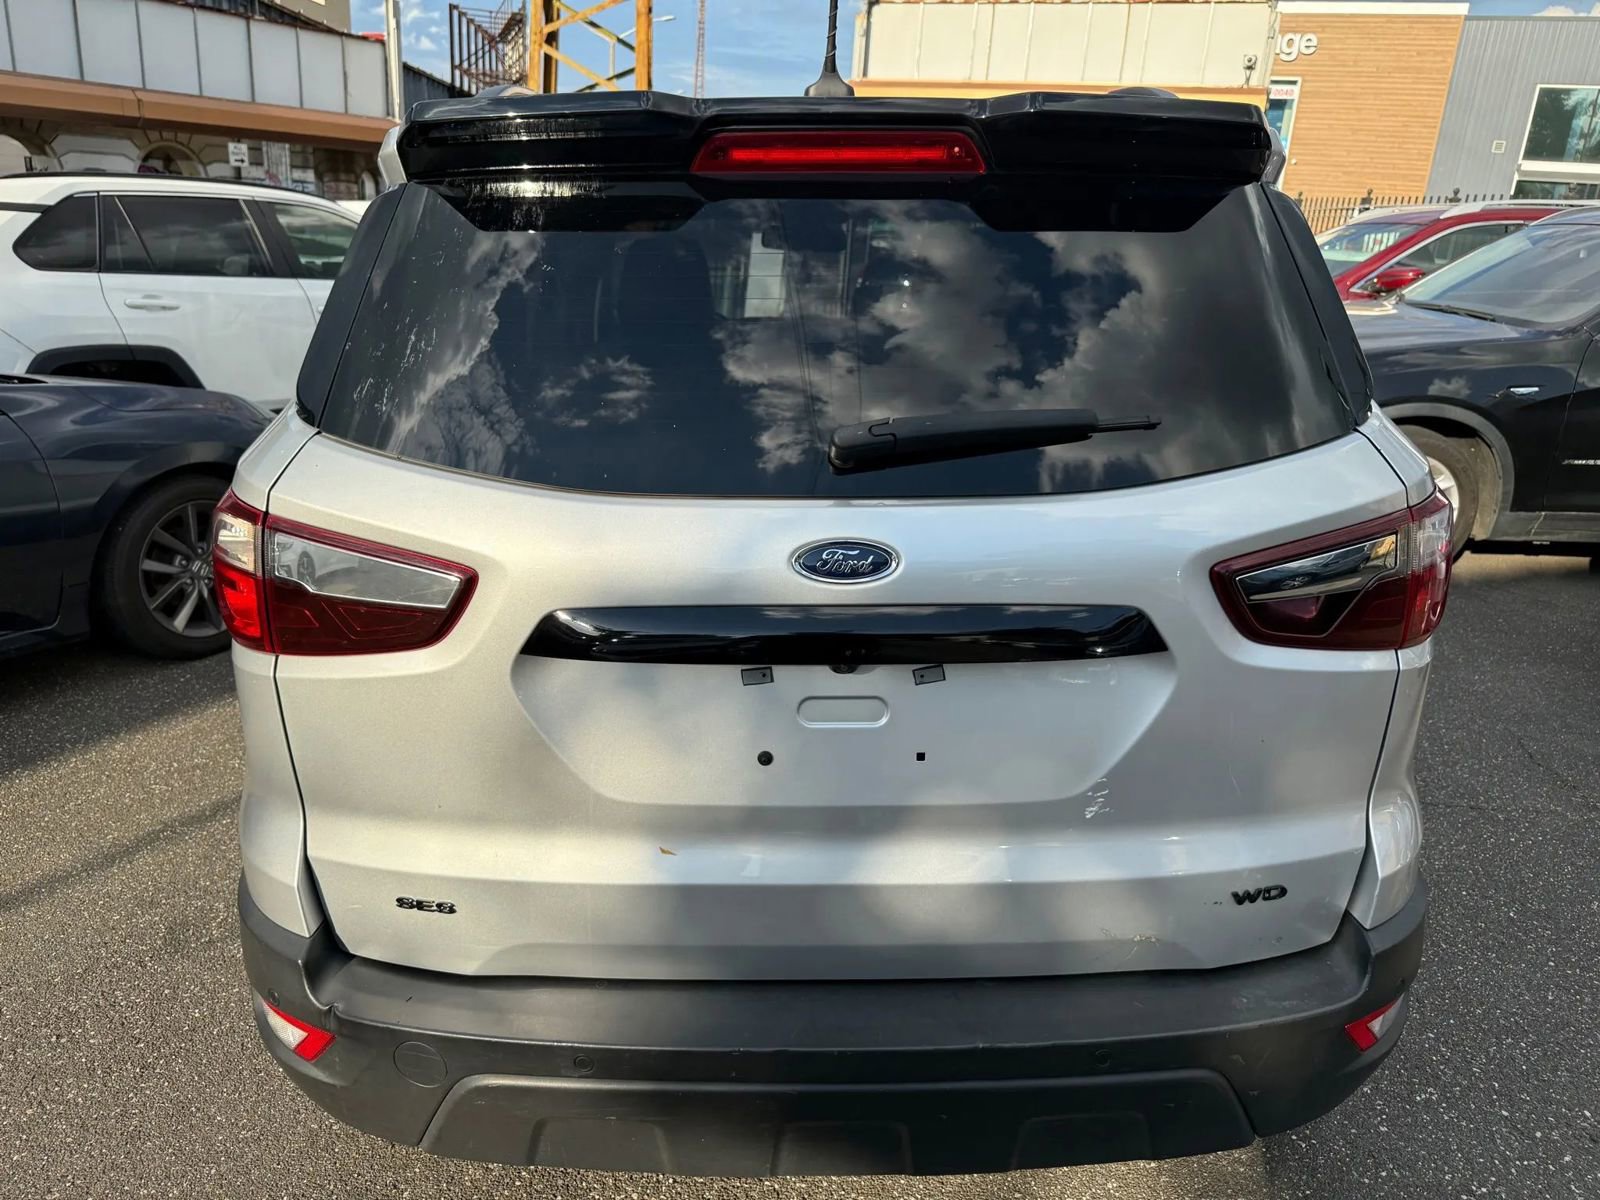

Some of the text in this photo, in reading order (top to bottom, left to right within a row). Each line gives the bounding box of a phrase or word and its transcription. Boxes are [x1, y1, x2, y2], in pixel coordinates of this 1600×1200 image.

[816, 548, 874, 573] Ford
[1231, 885, 1288, 905] WD
[396, 897, 457, 914] SES
